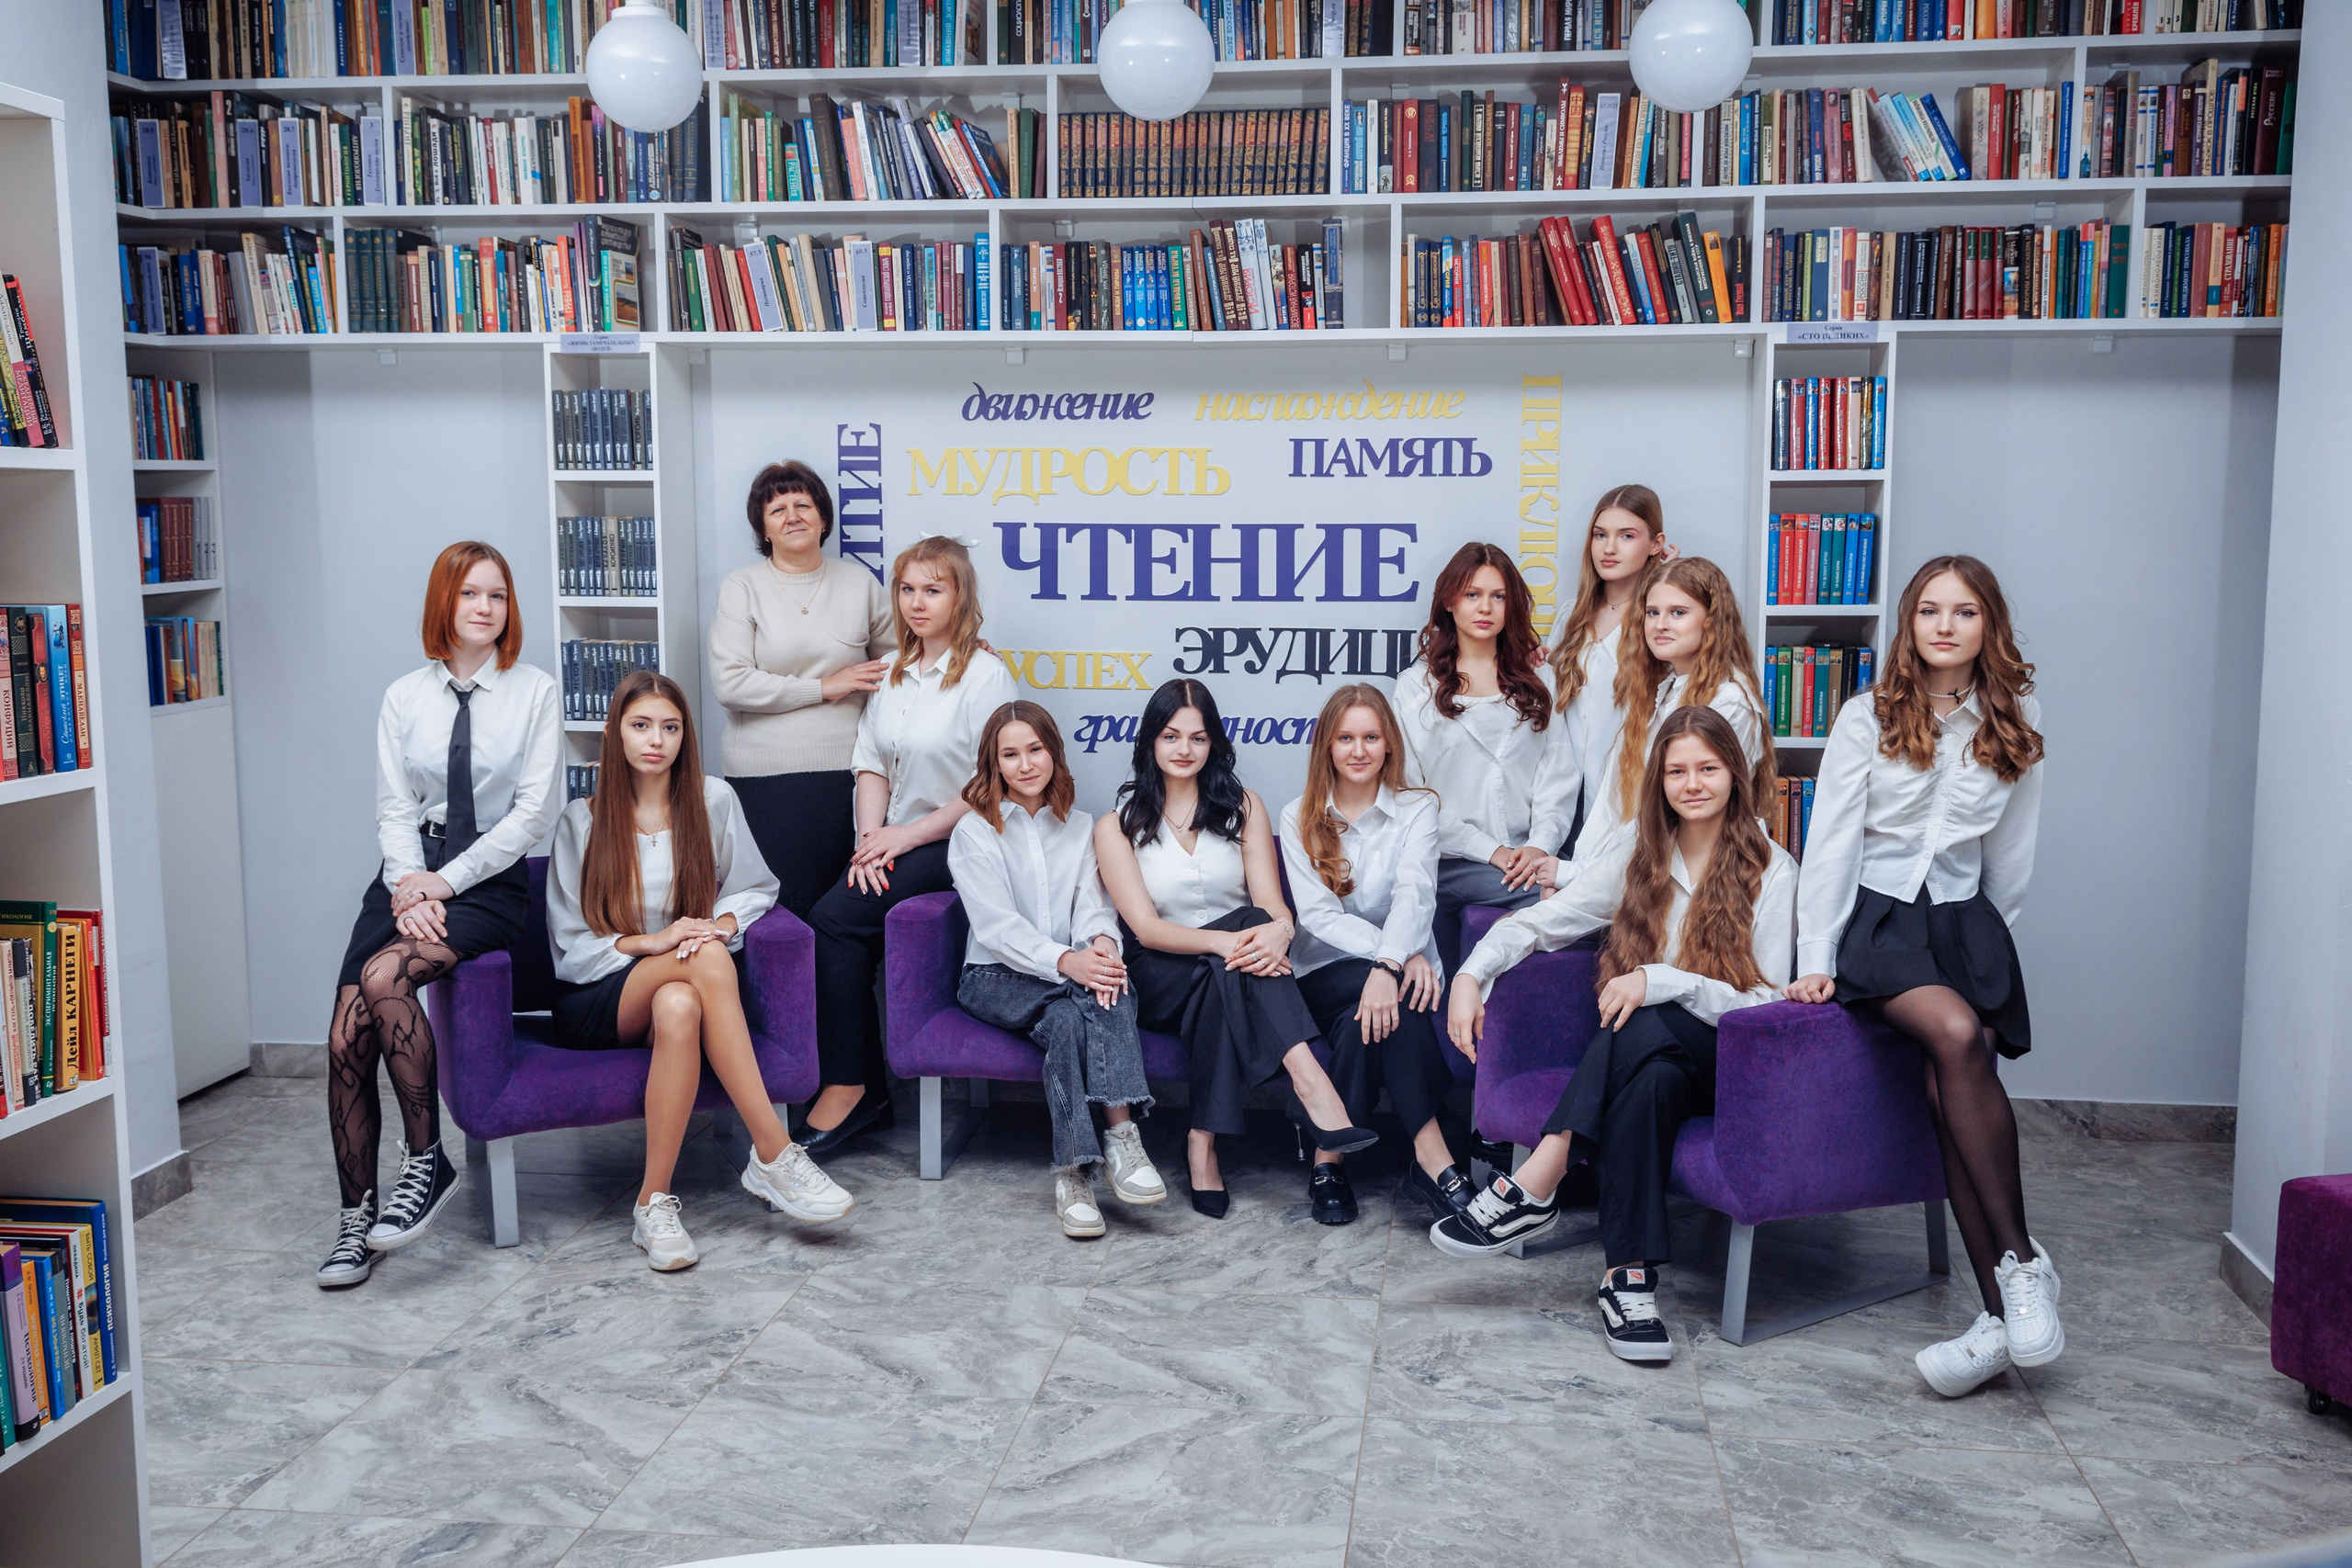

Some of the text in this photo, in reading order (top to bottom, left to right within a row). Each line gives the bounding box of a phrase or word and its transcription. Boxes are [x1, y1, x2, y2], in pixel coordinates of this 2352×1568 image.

[2264, 92, 2277, 126] Русские
[1633, 103, 1648, 182] АЛЬБОМ ПО ИСТОРИИ
[1844, 122, 1852, 141] СМЕРТЬ
[342, 145, 350, 196] ГЕРОНТОЛОГИЯ
[352, 135, 362, 190] АНТРОПОЛОГИЯ
[787, 162, 797, 196] РАСТЕНИЯ
[750, 249, 763, 257] 57.3
[1634, 257, 1644, 285] ИМПЕРИИ
[1669, 244, 1683, 285] СТАЛИН-ТИТО
[1685, 223, 1702, 290] ГРАЖДАНСКАЯ ВОЕННАЯ
[2154, 235, 2162, 302] МИКРОЭКОНОМИКА
[2225, 237, 2234, 280] СТРАХОВАНИЕ
[311, 279, 321, 302] САЛАТЫ
[759, 277, 769, 307] Педиатрия
[1170, 250, 1182, 311] ВСЕОБЩАЯ ИСТОРИЯ
[1219, 263, 1232, 300] ДРЕВНИЙ МИР
[1236, 276, 1245, 302] ДРЕВНИЙ
[1242, 267, 1259, 314] ИСТОРИЯ
[1288, 273, 1296, 297] ИСТОРИЯ
[1735, 283, 1744, 315] Иван Грозный
[562, 291, 571, 313] ГРИБЫ
[1289, 298, 1299, 328] ВСЕМИРНАЯ
[16, 308, 25, 339] Тропами
[16, 370, 33, 426] МЕДИТАЦИИ
[20, 369, 37, 424] ЕЖЕДНЕВНЫЕ
[961, 381, 1154, 421] движение
[1195, 379, 1465, 421] наслаждение
[906, 446, 1231, 504] МУДРОСТЬ
[1289, 437, 1493, 478] ПАМЯТЬ
[1519, 372, 1562, 637] ПРИКЛЮЧ
[993, 522, 1419, 602] ЧТЕНИЕ
[998, 649, 1153, 691] УСПЕХ
[4, 690, 13, 748] КОНФУЦИЙ
[60, 705, 69, 744] Светский
[77, 683, 85, 737] МАКИАВЕЛЛИ
[64, 935, 78, 1068] Дейл КАРНЕГИ
[21, 983, 32, 1069] ПСИХОЛОГИЯ УПРАВЛЕНИЯ
[103, 1264, 114, 1330] ПСИХОЛОГИЯ
[51, 1315, 61, 1368] ПОДРОСТОК
[61, 1314, 69, 1369] ПСИХОЛОГИЯ
[69, 1320, 75, 1332] не
[24, 1334, 38, 1403] Психология
[30, 1314, 46, 1405] ВОЗРАСТНАЯ ПСИХОЛОГИЯ
[81, 1328, 89, 1370] богатой!
